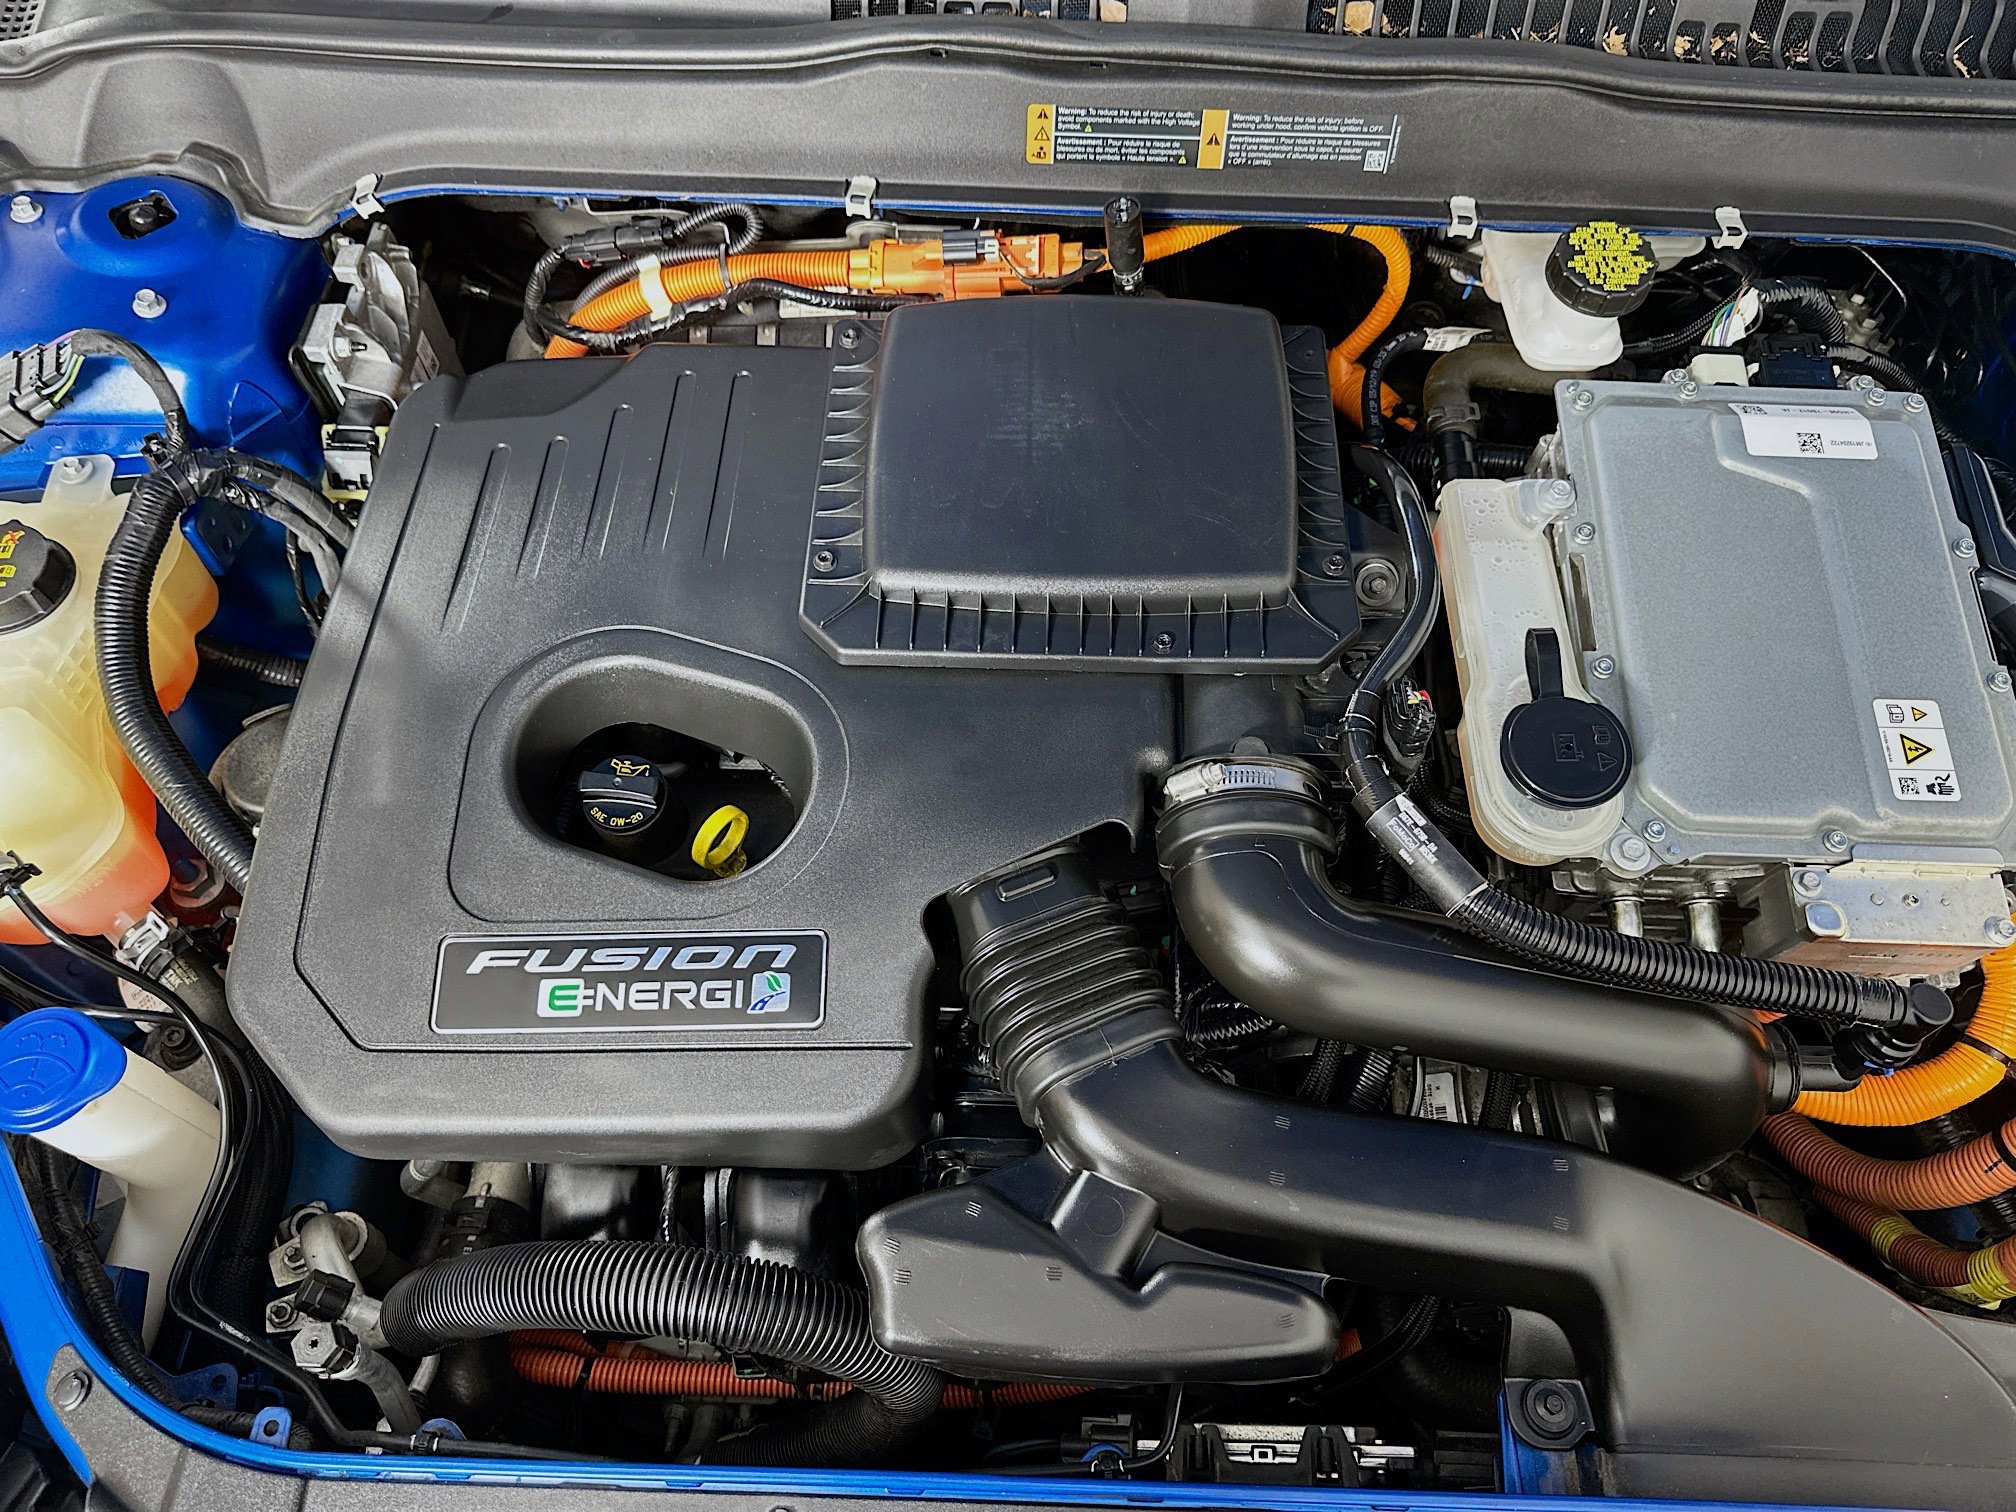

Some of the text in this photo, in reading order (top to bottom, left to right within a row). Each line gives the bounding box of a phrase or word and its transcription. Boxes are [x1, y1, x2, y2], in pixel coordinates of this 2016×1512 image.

[1058, 107, 1087, 116] Warning:
[1097, 108, 1118, 116] reduce
[1150, 110, 1167, 119] injury
[1162, 118, 1176, 127] High
[1178, 119, 1200, 128] Voltage
[1233, 114, 1262, 123] Warning:
[1232, 122, 1256, 130] working
[1057, 137, 1102, 145] Avertissement
[1230, 136, 1276, 144] Avertissement
[1286, 152, 1318, 161] d'allumage
[590, 807, 644, 826] SAE 0W-20
[1389, 820, 1415, 849] FoMoCo
[466, 944, 797, 975] FUSION
[547, 979, 744, 1011] ENERGI
